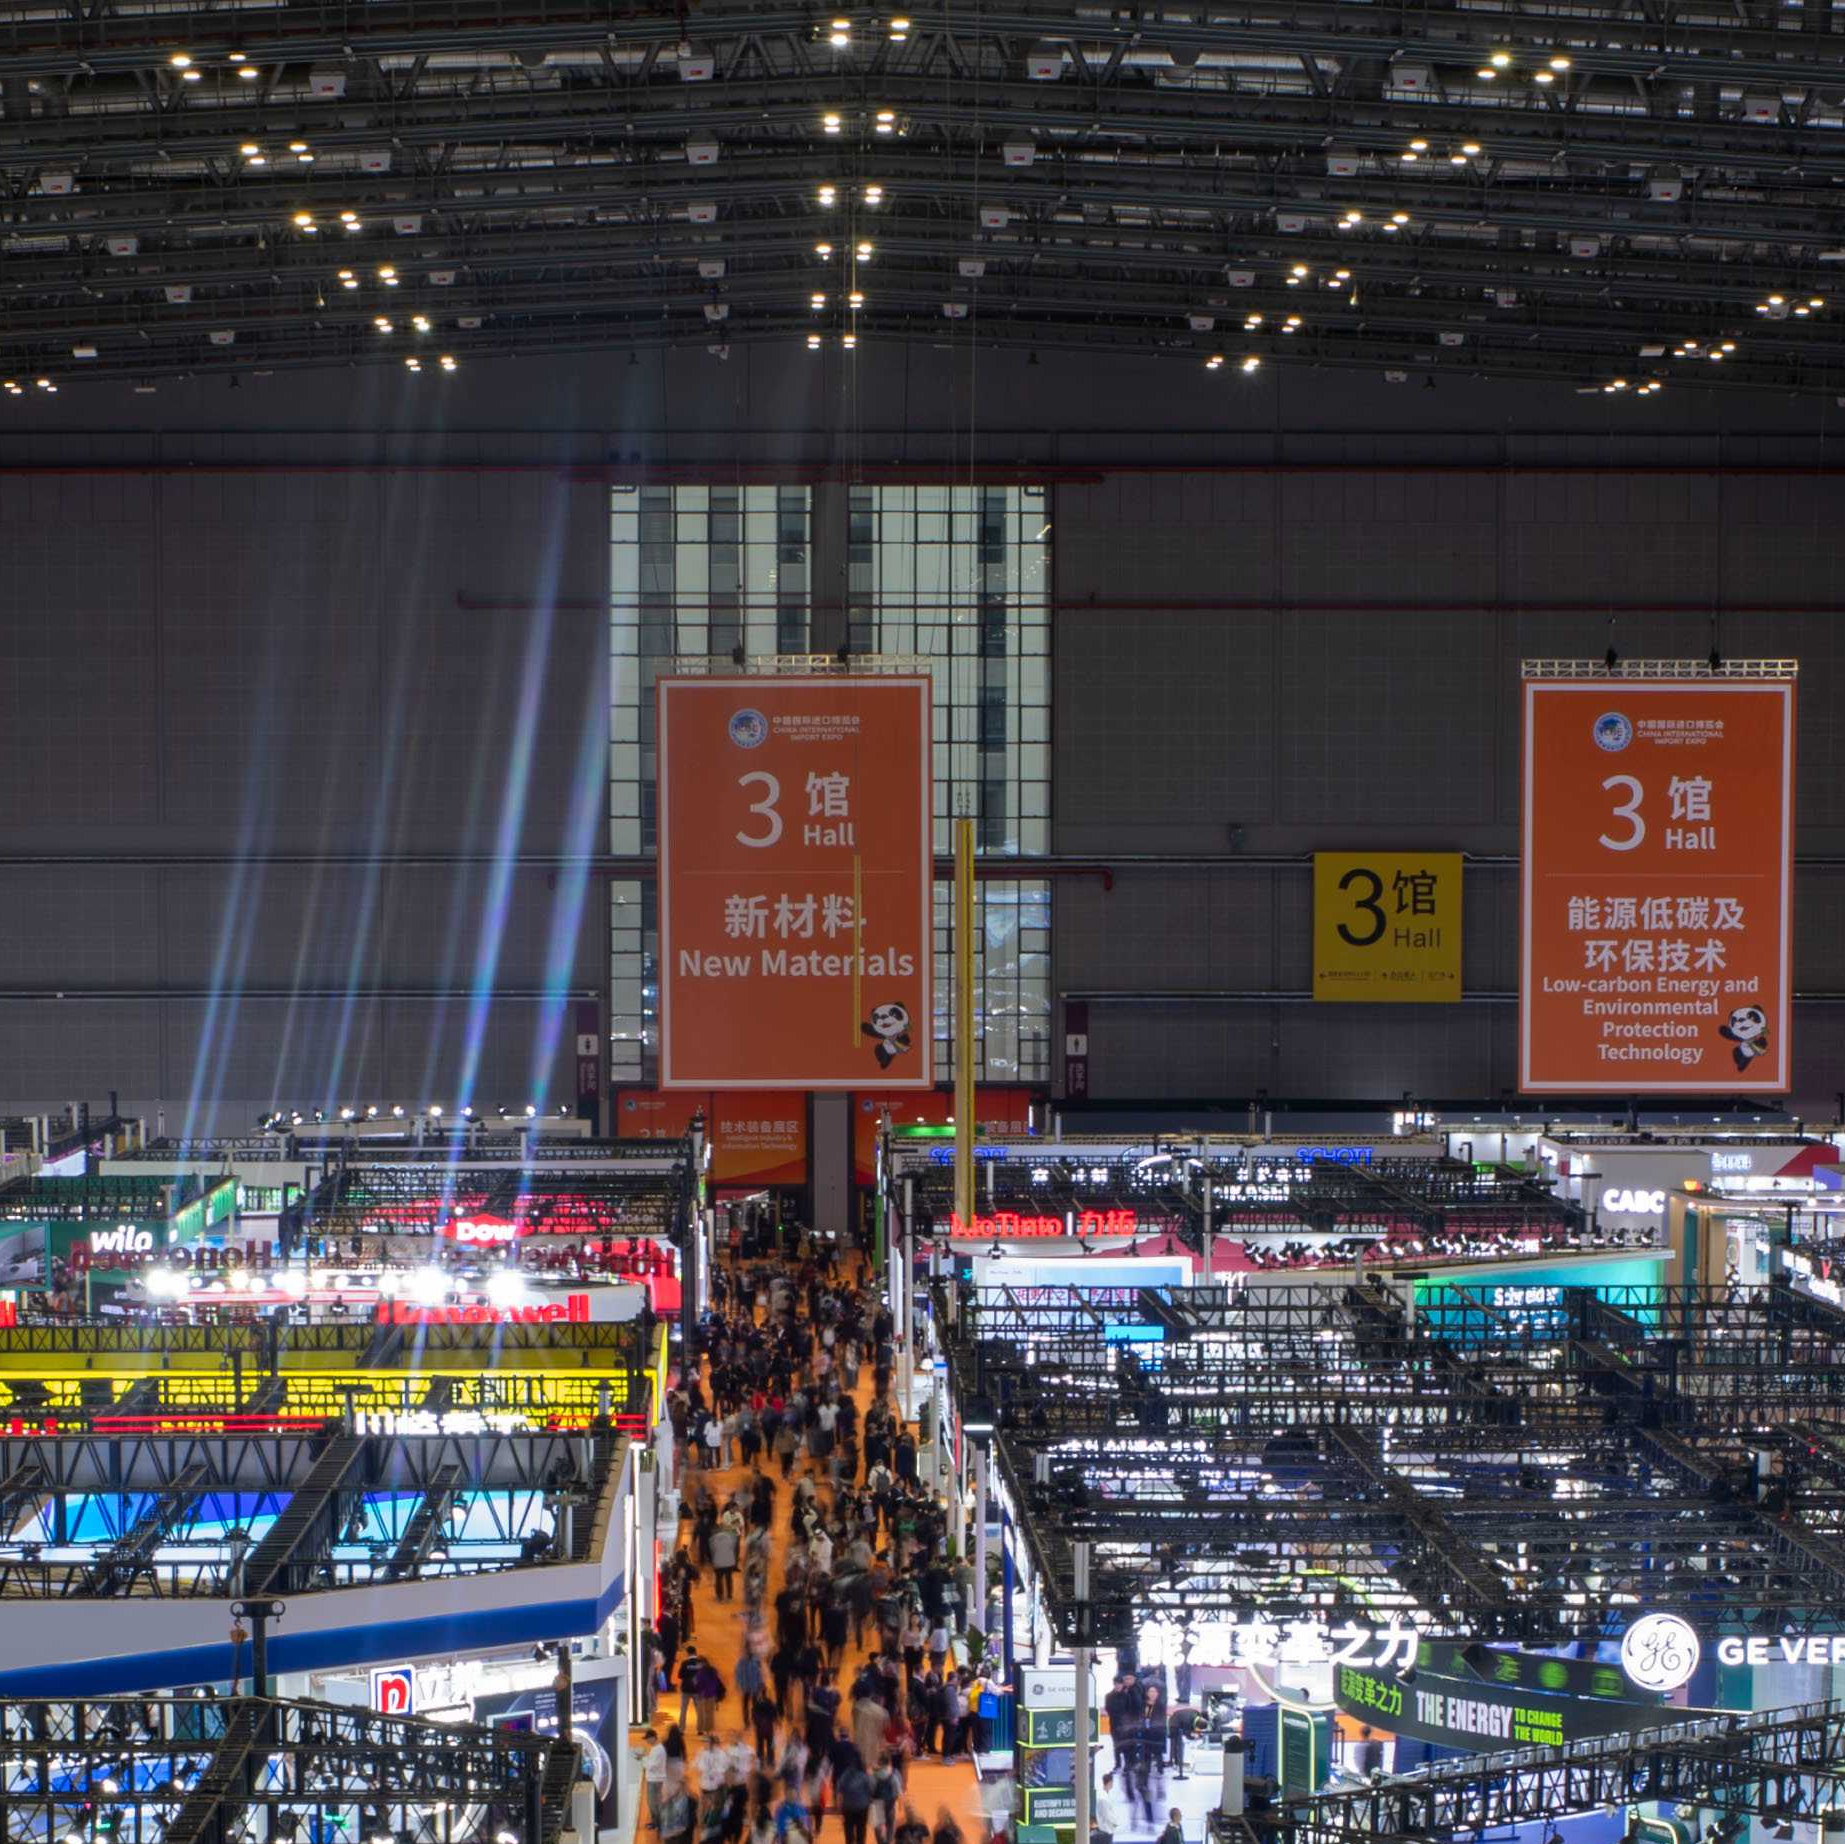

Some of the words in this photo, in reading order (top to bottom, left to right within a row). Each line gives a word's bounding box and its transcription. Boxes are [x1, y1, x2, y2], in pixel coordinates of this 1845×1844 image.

[735, 771, 783, 848] 3
[805, 772, 850, 817] 馆
[1598, 775, 1646, 851] 3
[1668, 776, 1712, 821] 馆
[804, 824, 854, 846] Hall
[1665, 828, 1716, 850] Hall
[724, 894, 866, 938] 新材料
[1337, 868, 1387, 947] 3
[1392, 869, 1437, 916] 馆
[1568, 896, 1744, 931] 能源低碳及
[1394, 928, 1441, 948] Hall
[679, 950, 751, 977] New
[761, 948, 914, 977] Materials
[1584, 939, 1726, 974] 环保技术
[1543, 976, 1651, 993] Low-carbon
[1657, 976, 1720, 997] Energy
[1724, 976, 1759, 993] and
[1583, 998, 1718, 1016] Environmental
[1602, 1021, 1698, 1039] Protection
[1597, 1043, 1704, 1065] Technology
[91, 1225, 153, 1253] wilo
[1138, 1620, 1419, 1667] 能源变革之力
[1718, 1637, 1767, 1664] GE
[1340, 1667, 1403, 1717] 能源变革之力
[1416, 1691, 1444, 1727] THE
[1446, 1697, 1513, 1738] ENERGY
[1515, 1708, 1526, 1720] TO
[1527, 1710, 1563, 1728] CHANGE
[1515, 1726, 1530, 1741] THE
[1531, 1728, 1564, 1746] WORLD
